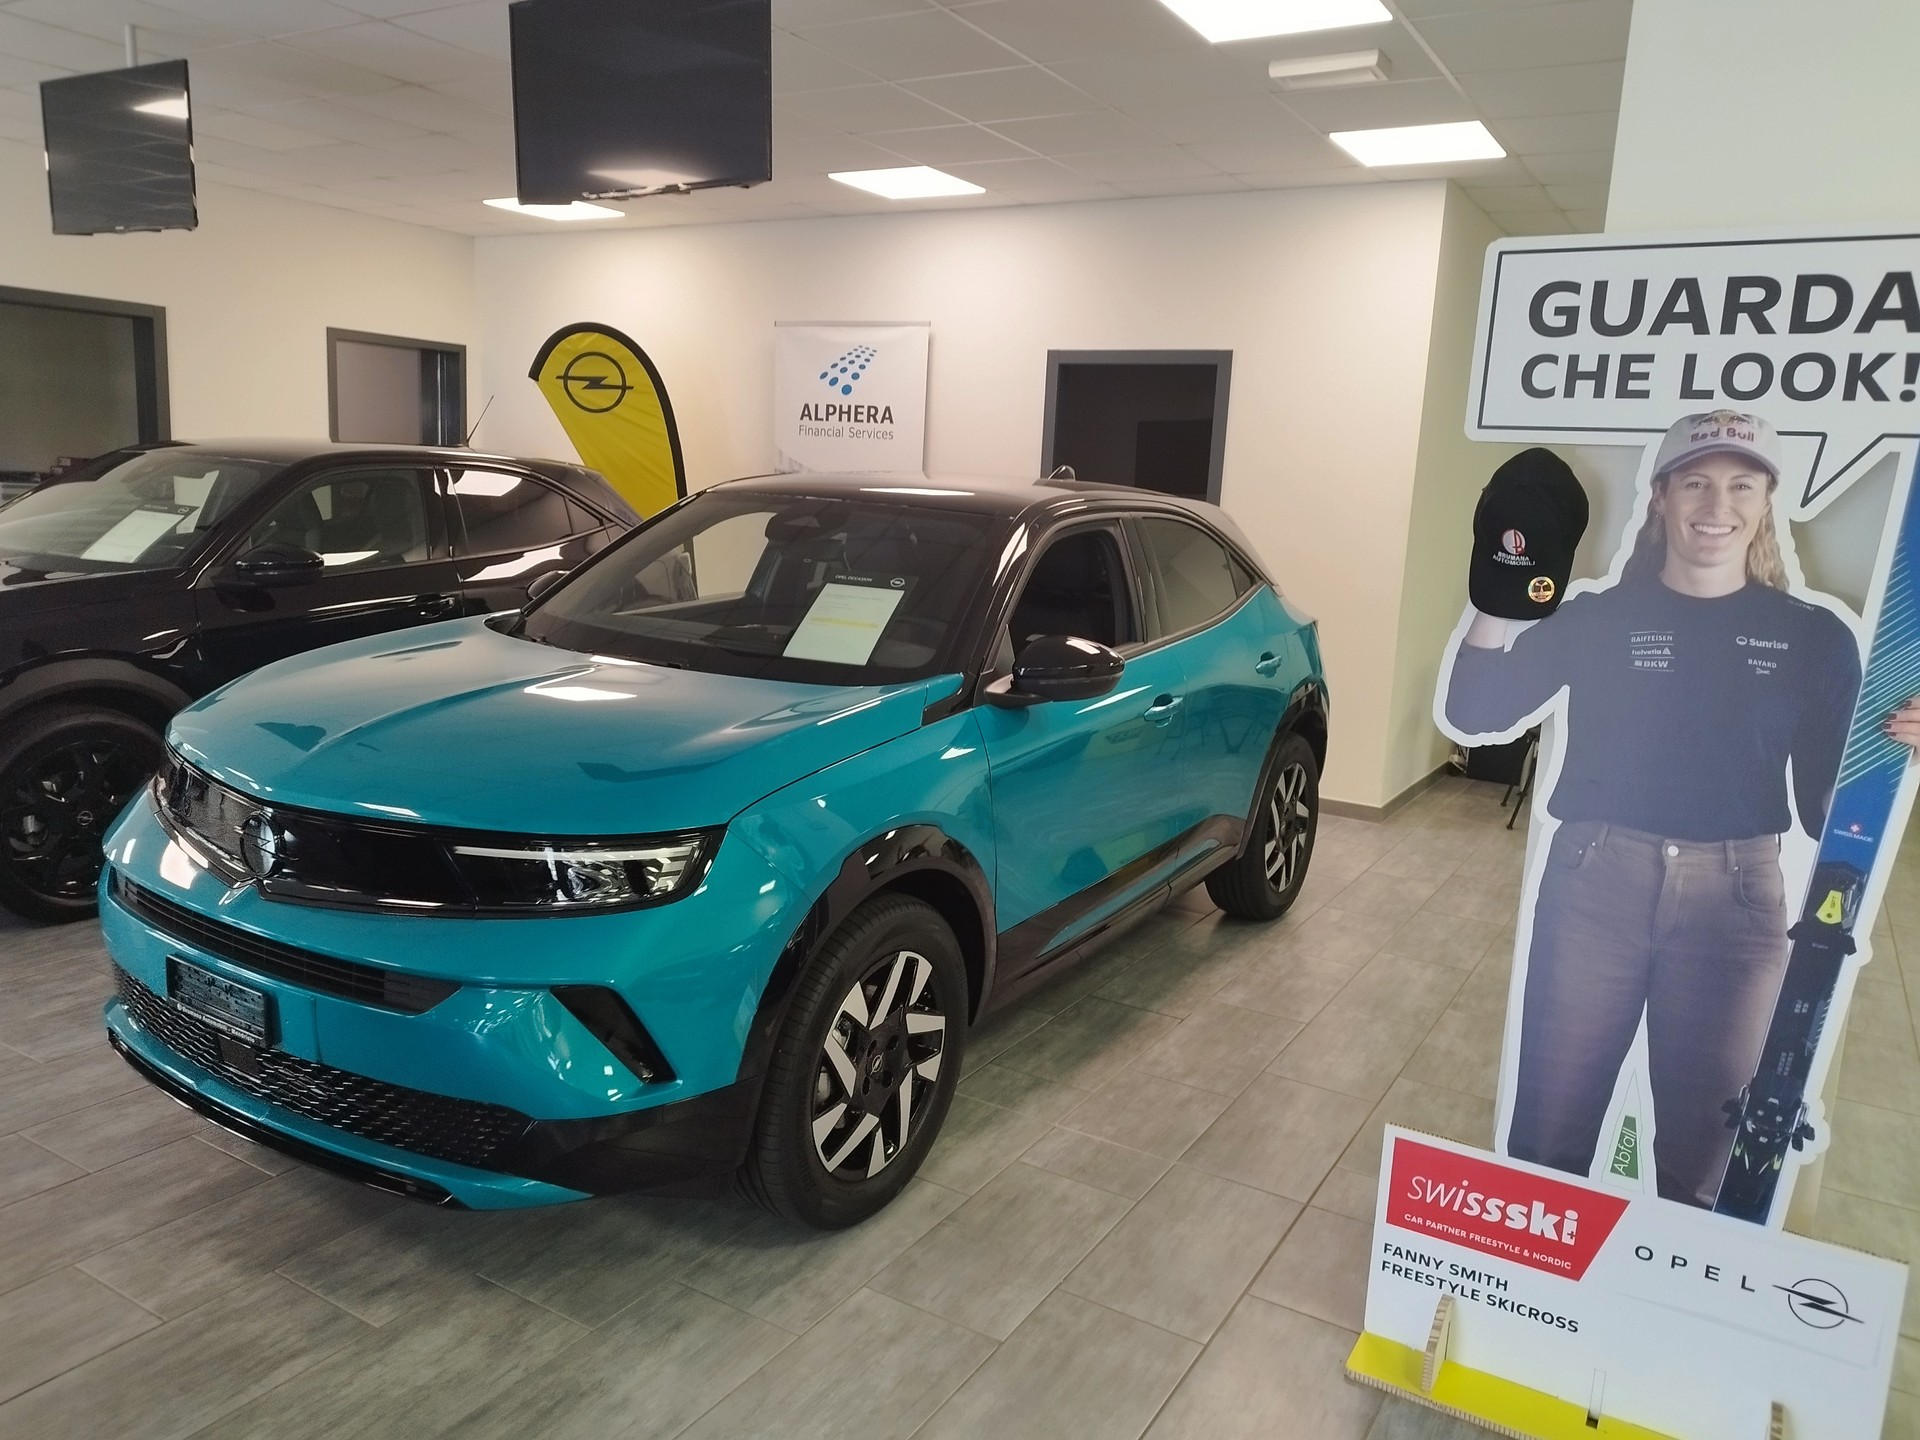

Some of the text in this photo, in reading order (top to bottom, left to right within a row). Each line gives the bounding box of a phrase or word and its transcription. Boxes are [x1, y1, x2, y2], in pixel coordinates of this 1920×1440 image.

[1528, 271, 1920, 338] GUARDA
[1521, 352, 1919, 402] CHE LOOK!
[799, 403, 894, 424] ALPHERA
[798, 424, 894, 440] Financial Services
[1690, 427, 1755, 443] Red Bull
[1492, 554, 1536, 566] AUTOMOBILI
[1631, 634, 1673, 643] RAIFFEISEN
[1749, 638, 1789, 650] Sunrise
[1632, 648, 1662, 656] helvetia
[1643, 660, 1669, 669] BKW
[1748, 658, 1777, 669] BAYARD
[1613, 1126, 1637, 1176] Abfall
[1404, 1213, 1572, 1270] CAR PARTNER FREESTYLE & NORDIC
[1383, 1242, 1509, 1292] FANNY SMITH
[1635, 1245, 1755, 1293] OPEL
[1381, 1260, 1579, 1333] FREESTYLE SKICROSS
